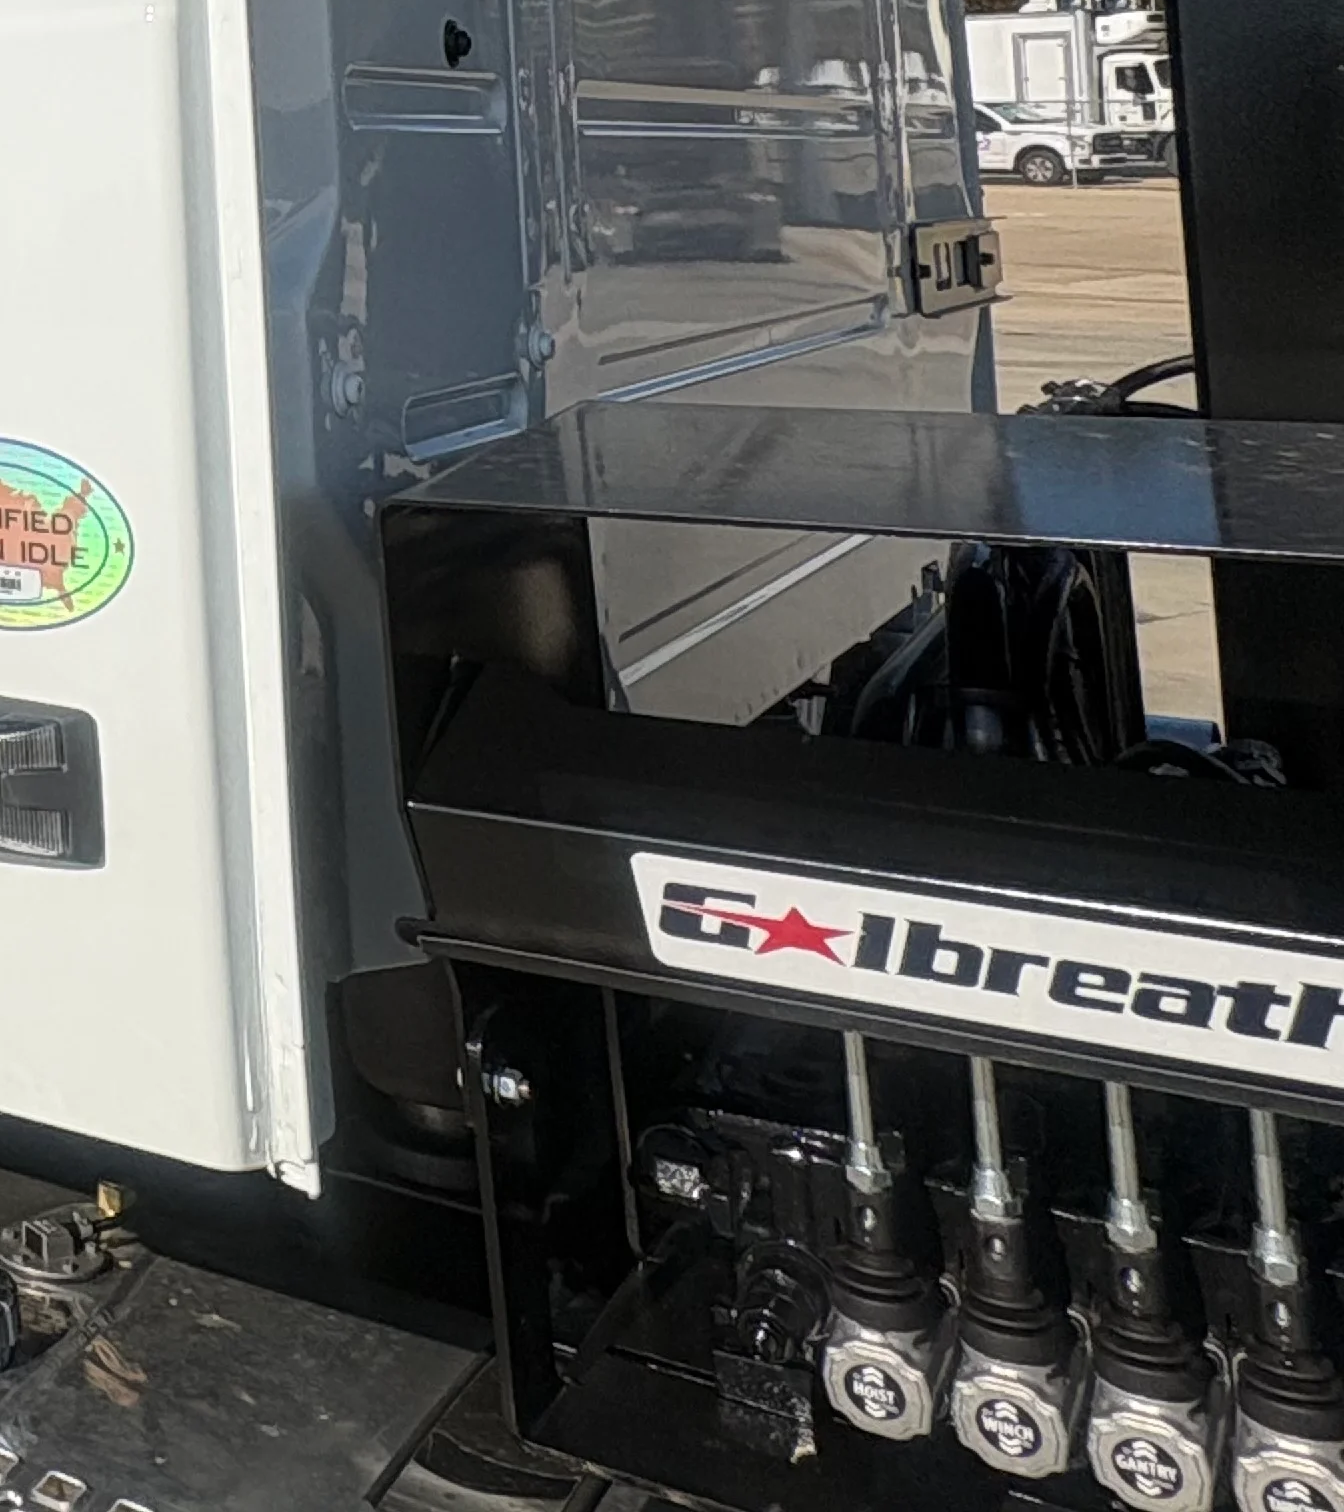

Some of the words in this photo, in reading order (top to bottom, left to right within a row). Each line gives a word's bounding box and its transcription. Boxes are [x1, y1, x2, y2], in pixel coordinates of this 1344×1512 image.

[21, 540, 90, 569] IDLE
[852, 1379, 895, 1405] HOIST
[981, 1414, 1035, 1442] WINCH
[1115, 1452, 1178, 1483] GANTRY
